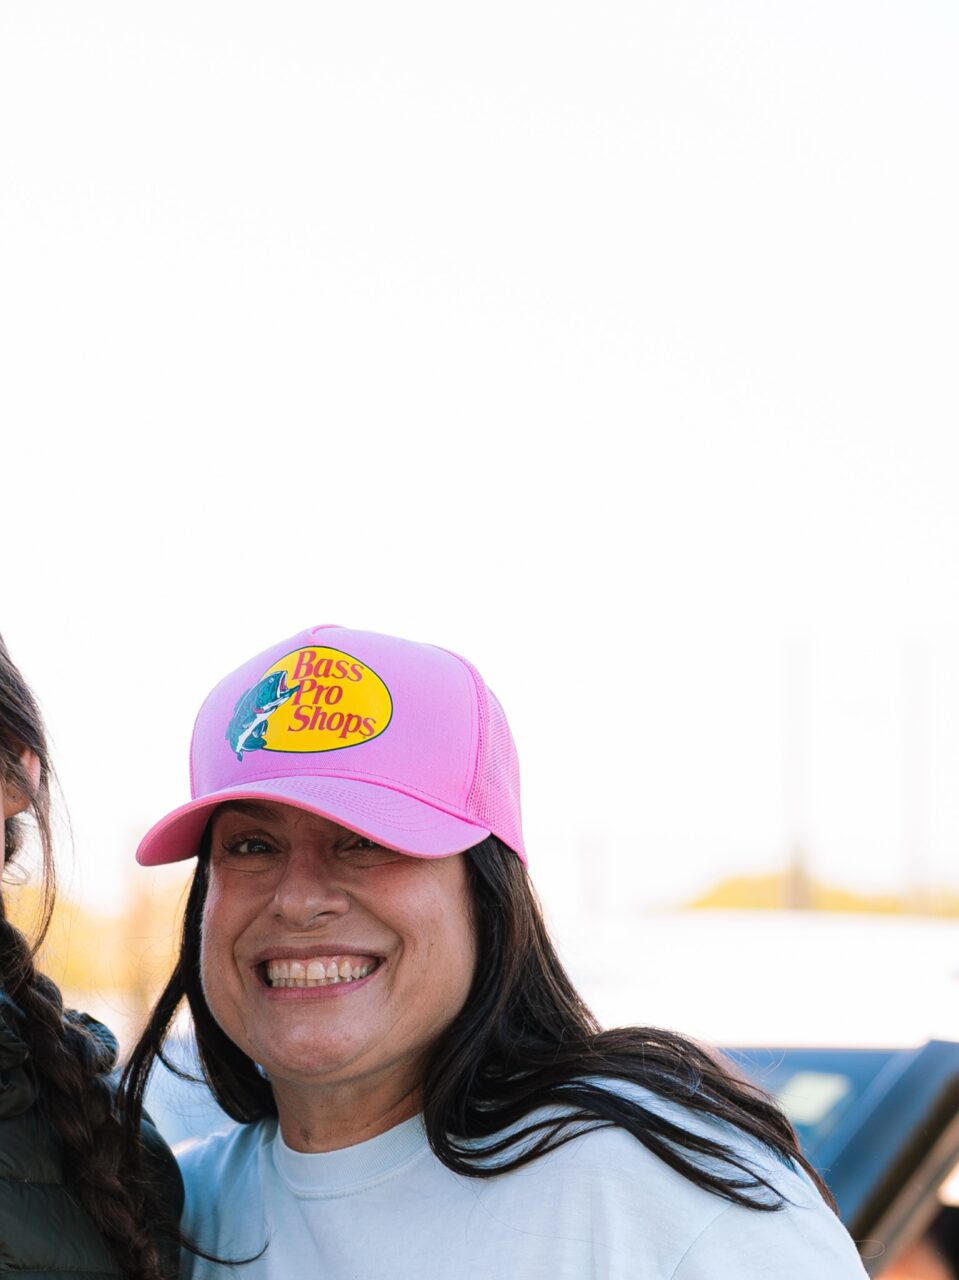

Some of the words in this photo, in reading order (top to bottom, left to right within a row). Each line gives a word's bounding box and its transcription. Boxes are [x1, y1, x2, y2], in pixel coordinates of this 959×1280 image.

[291, 650, 364, 682] Bass
[291, 679, 343, 706] Pro
[288, 705, 377, 739] Shops
